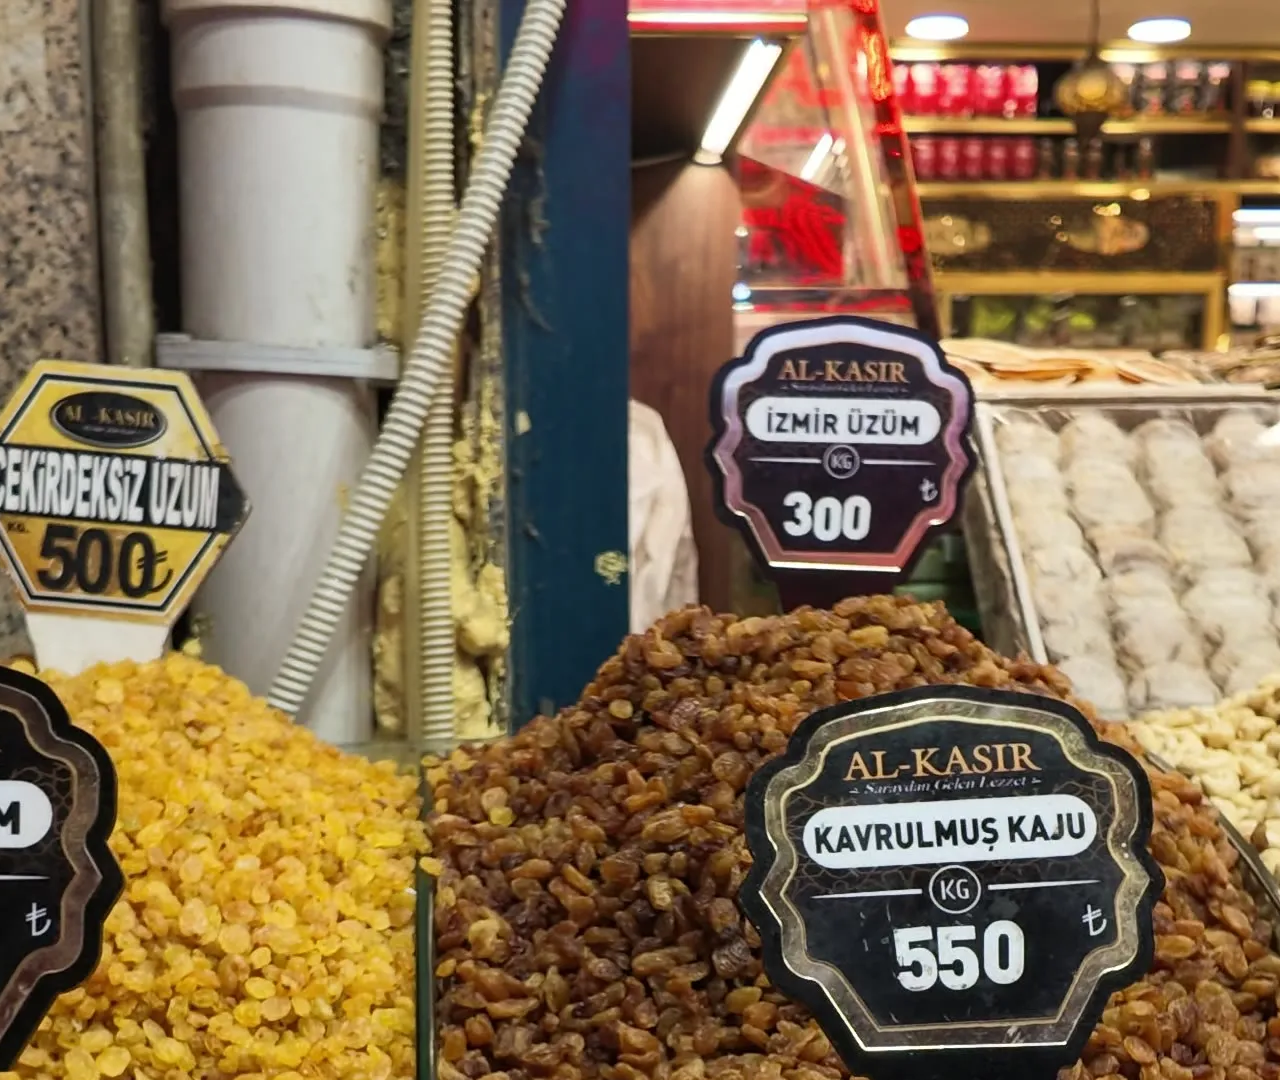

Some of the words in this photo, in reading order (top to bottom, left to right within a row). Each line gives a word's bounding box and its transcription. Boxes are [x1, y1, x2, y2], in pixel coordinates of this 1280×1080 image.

[777, 359, 910, 384] AL-KASIR
[767, 405, 838, 435] İZMİR
[847, 407, 919, 436] ÜZÜM
[831, 453, 853, 470] KG
[782, 490, 872, 542] 300
[843, 743, 1042, 782] AL-KASIR
[864, 781, 931, 796] Saraydan
[934, 778, 975, 792] Gelen
[979, 776, 1027, 790] Lezzet
[814, 817, 998, 854] KAVRULMUŞ
[1008, 812, 1086, 844] KAJU
[940, 878, 970, 901] KG
[893, 920, 1025, 992] 550
